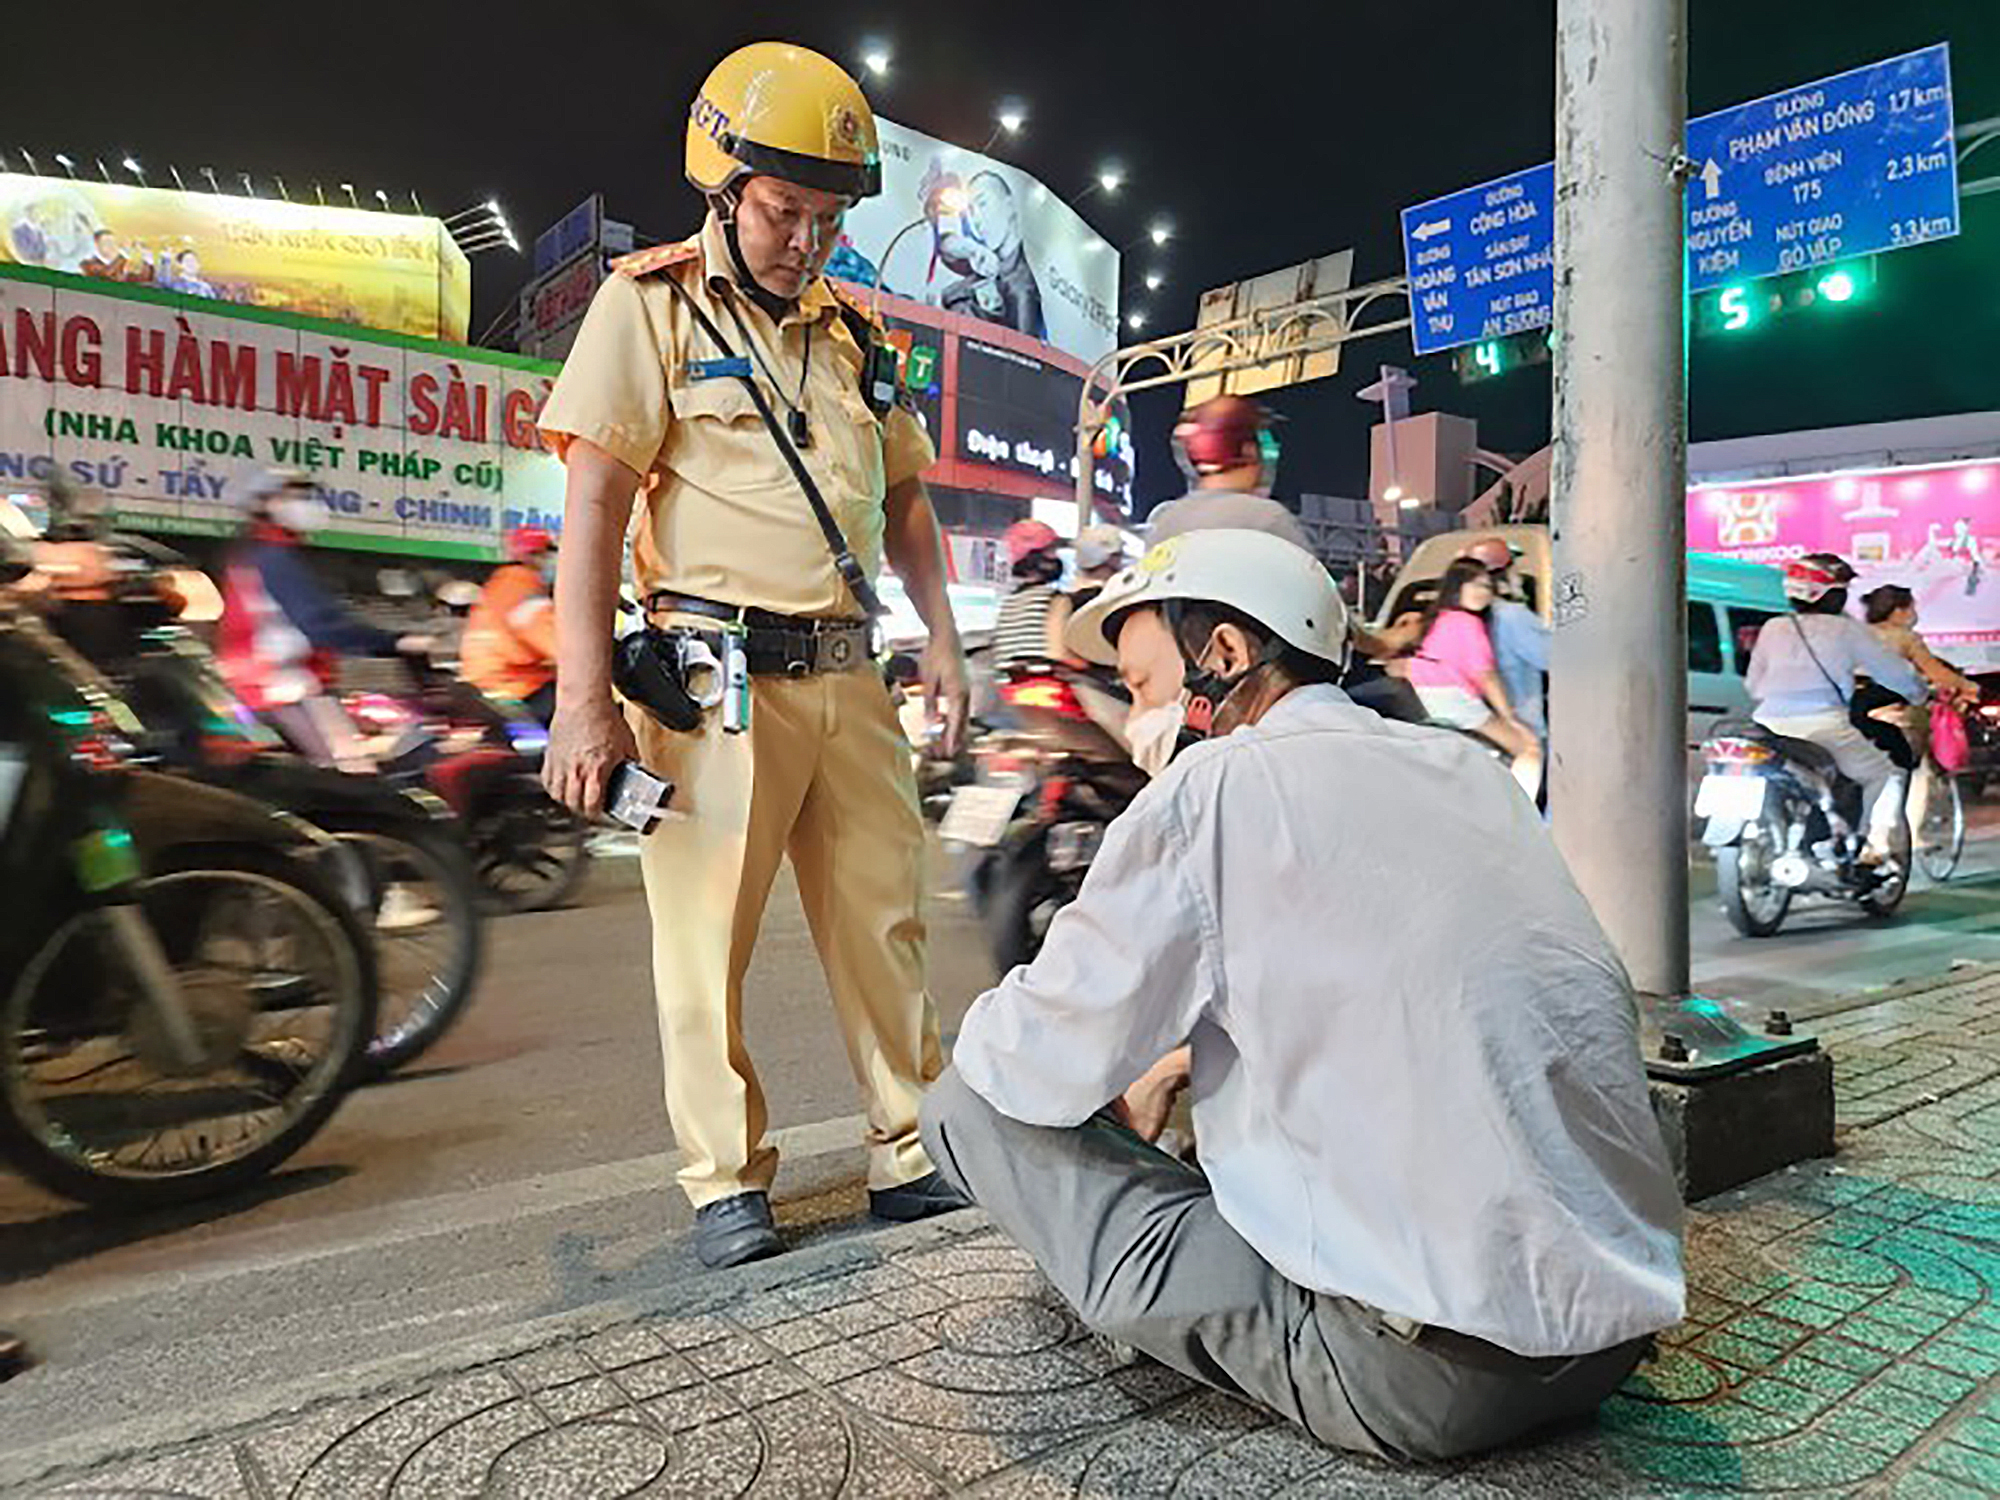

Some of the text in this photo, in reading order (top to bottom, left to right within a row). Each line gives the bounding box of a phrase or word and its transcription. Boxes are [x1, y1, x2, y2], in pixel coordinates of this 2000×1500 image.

[1917, 152, 1947, 173] km
[1793, 178, 1822, 204] 175
[1718, 287, 1748, 330] 5
[1475, 341, 1500, 375] 4
[0, 308, 102, 389] NG
[125, 316, 257, 412] HÀM
[275, 345, 390, 439] MẶT
[408, 363, 488, 444] SÀI
[44, 408, 503, 492] (NHA KHOA VIỆT PHÁP CŨ)
[70, 455, 128, 489] SỨ
